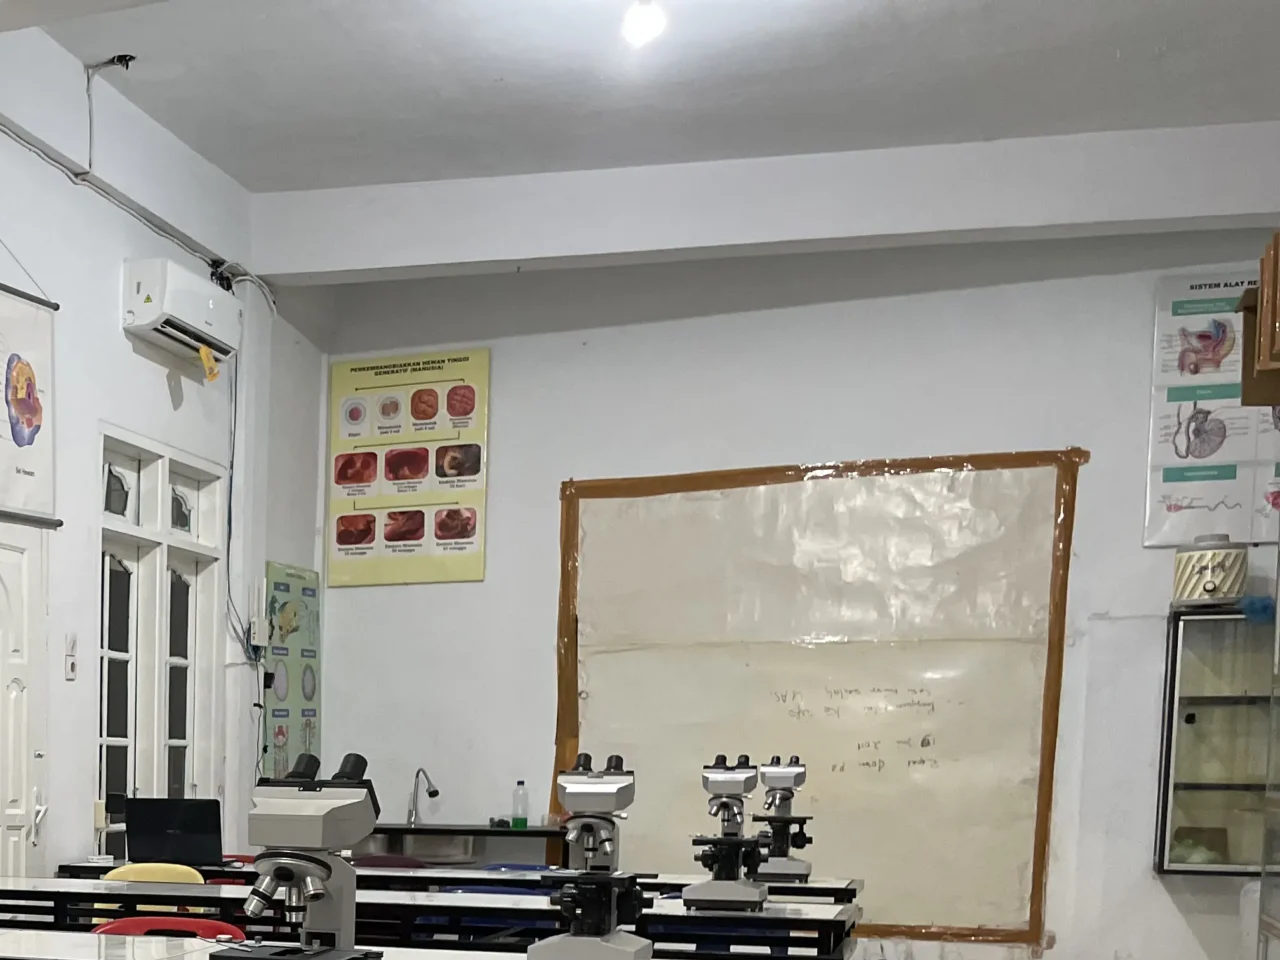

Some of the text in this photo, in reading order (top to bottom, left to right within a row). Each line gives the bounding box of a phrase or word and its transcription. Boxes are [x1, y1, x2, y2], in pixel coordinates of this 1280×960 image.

[1189, 282, 1221, 291] SISTEM
[1223, 280, 1245, 289] ALAT
[374, 368, 408, 377] GENERATIF
